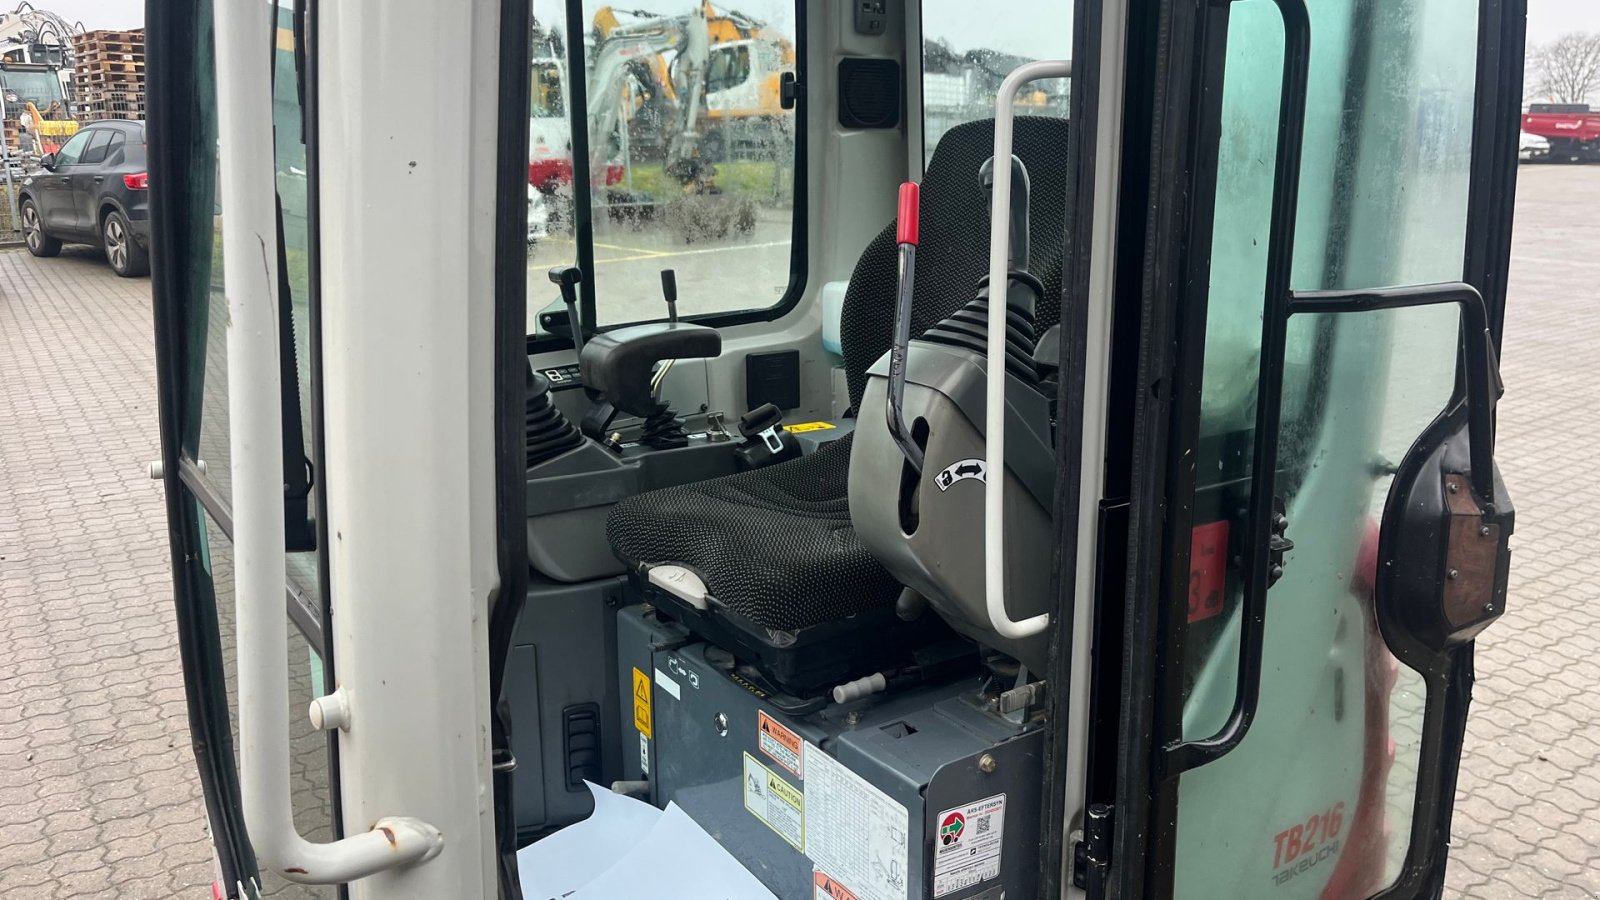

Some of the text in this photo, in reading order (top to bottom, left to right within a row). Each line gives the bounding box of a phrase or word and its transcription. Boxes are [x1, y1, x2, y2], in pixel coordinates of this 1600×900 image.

[772, 726, 798, 749] WARNING
[776, 783, 801, 807] CAUTION
[1272, 801, 1345, 869] TB216
